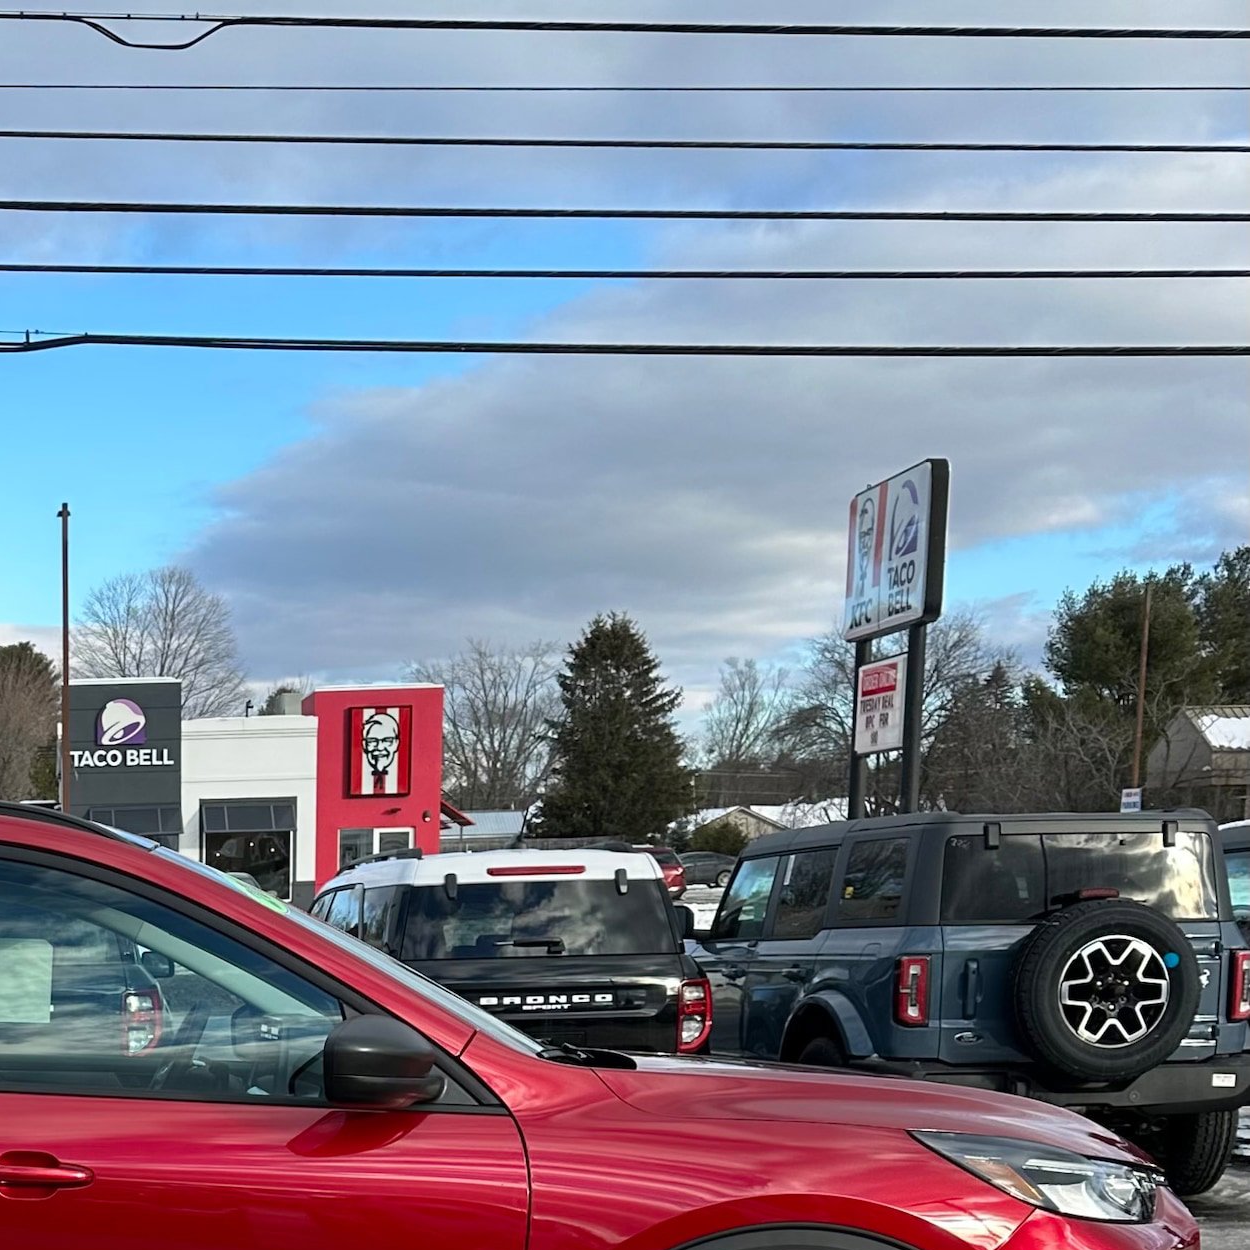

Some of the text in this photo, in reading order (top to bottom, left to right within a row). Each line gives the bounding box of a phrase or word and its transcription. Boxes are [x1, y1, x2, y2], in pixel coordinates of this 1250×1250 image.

[888, 560, 915, 590] TACO
[850, 598, 872, 629] KFC
[888, 587, 912, 616] BELL
[69, 749, 174, 767] TACO BELL
[479, 994, 613, 1005] BRONCO
